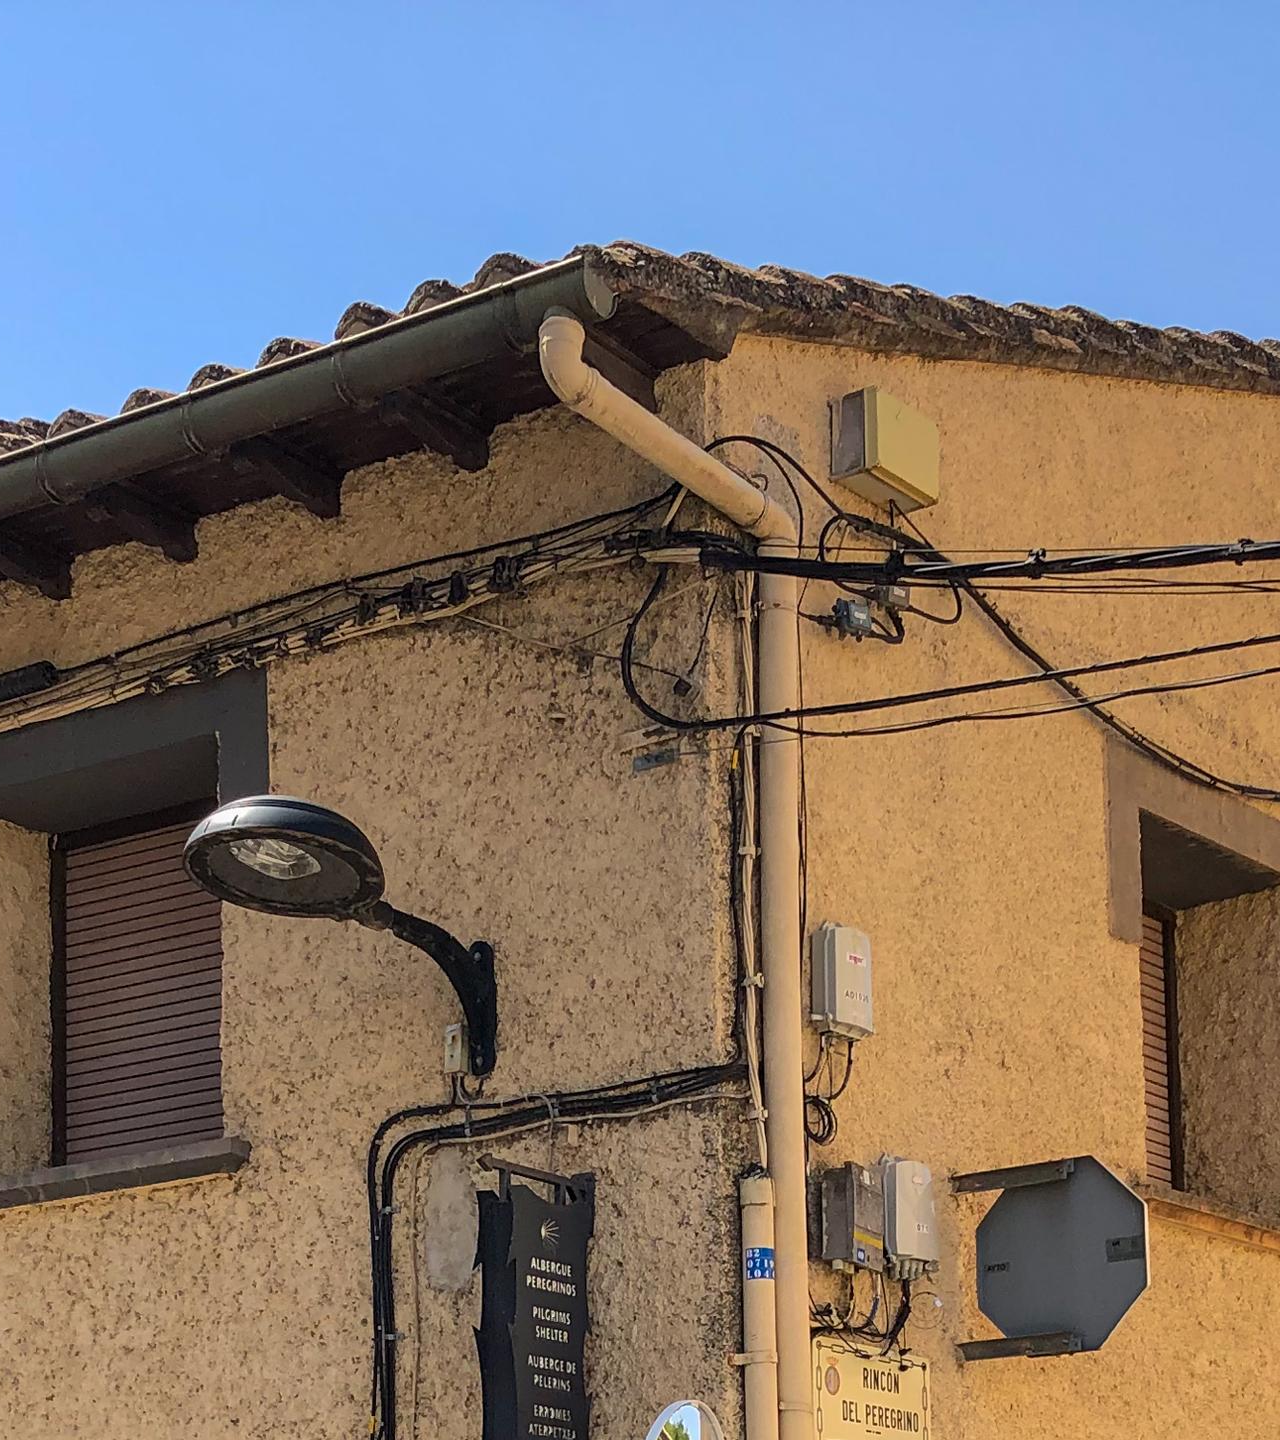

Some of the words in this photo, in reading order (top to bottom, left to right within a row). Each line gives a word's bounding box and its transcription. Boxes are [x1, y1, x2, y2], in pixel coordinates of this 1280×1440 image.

[531, 1257, 572, 1277] ALBERGUE
[526, 1275, 576, 1297] PEREGRINOS
[532, 1306, 571, 1325] PILGRIMS
[535, 1325, 569, 1344] SHELTER
[528, 1354, 565, 1372] AUBERGE
[566, 1361, 576, 1374] DE
[534, 1374, 571, 1392] PELERINS
[862, 1367, 900, 1394] RINCÓN
[842, 1400, 861, 1424] DEL
[865, 1404, 919, 1433] PEREGRINO
